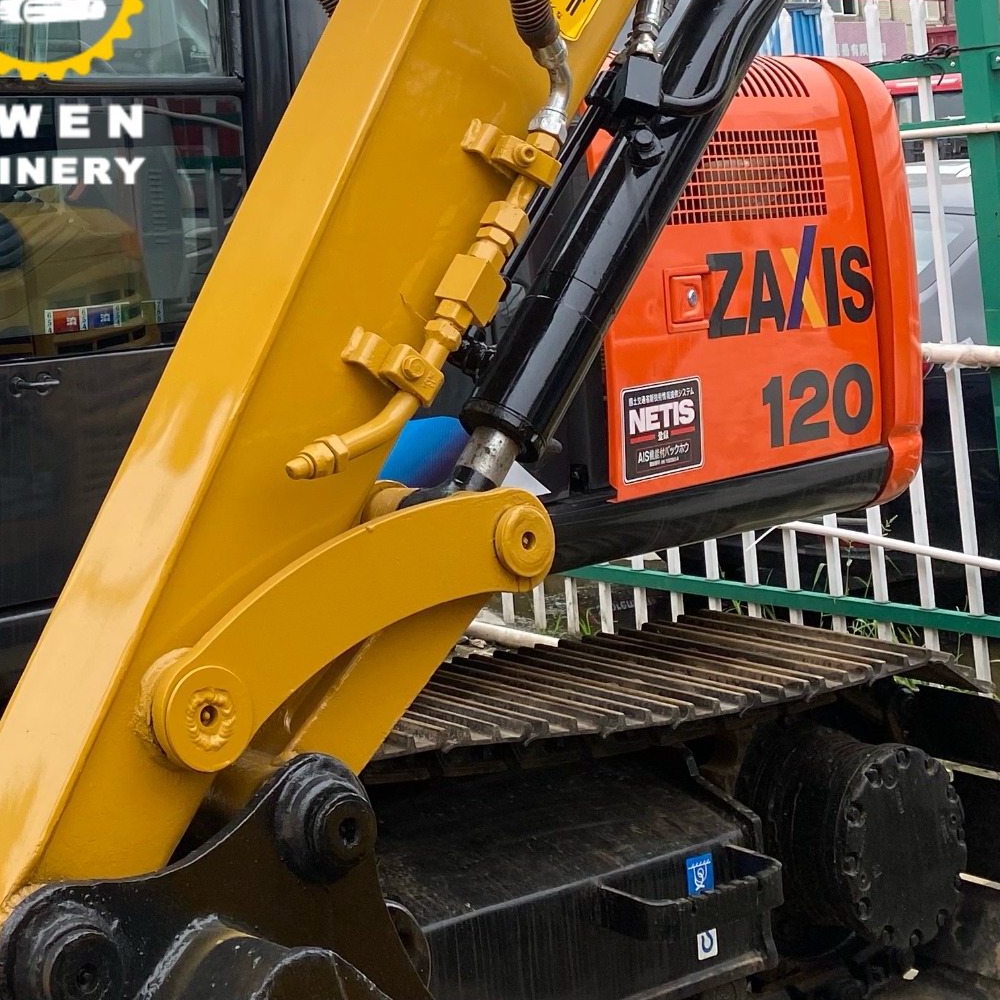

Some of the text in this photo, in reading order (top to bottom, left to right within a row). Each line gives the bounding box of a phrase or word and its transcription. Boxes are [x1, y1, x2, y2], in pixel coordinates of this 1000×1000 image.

[706, 225, 874, 339] ZAXIS
[629, 399, 695, 435] NETIS
[762, 363, 873, 449] 120
